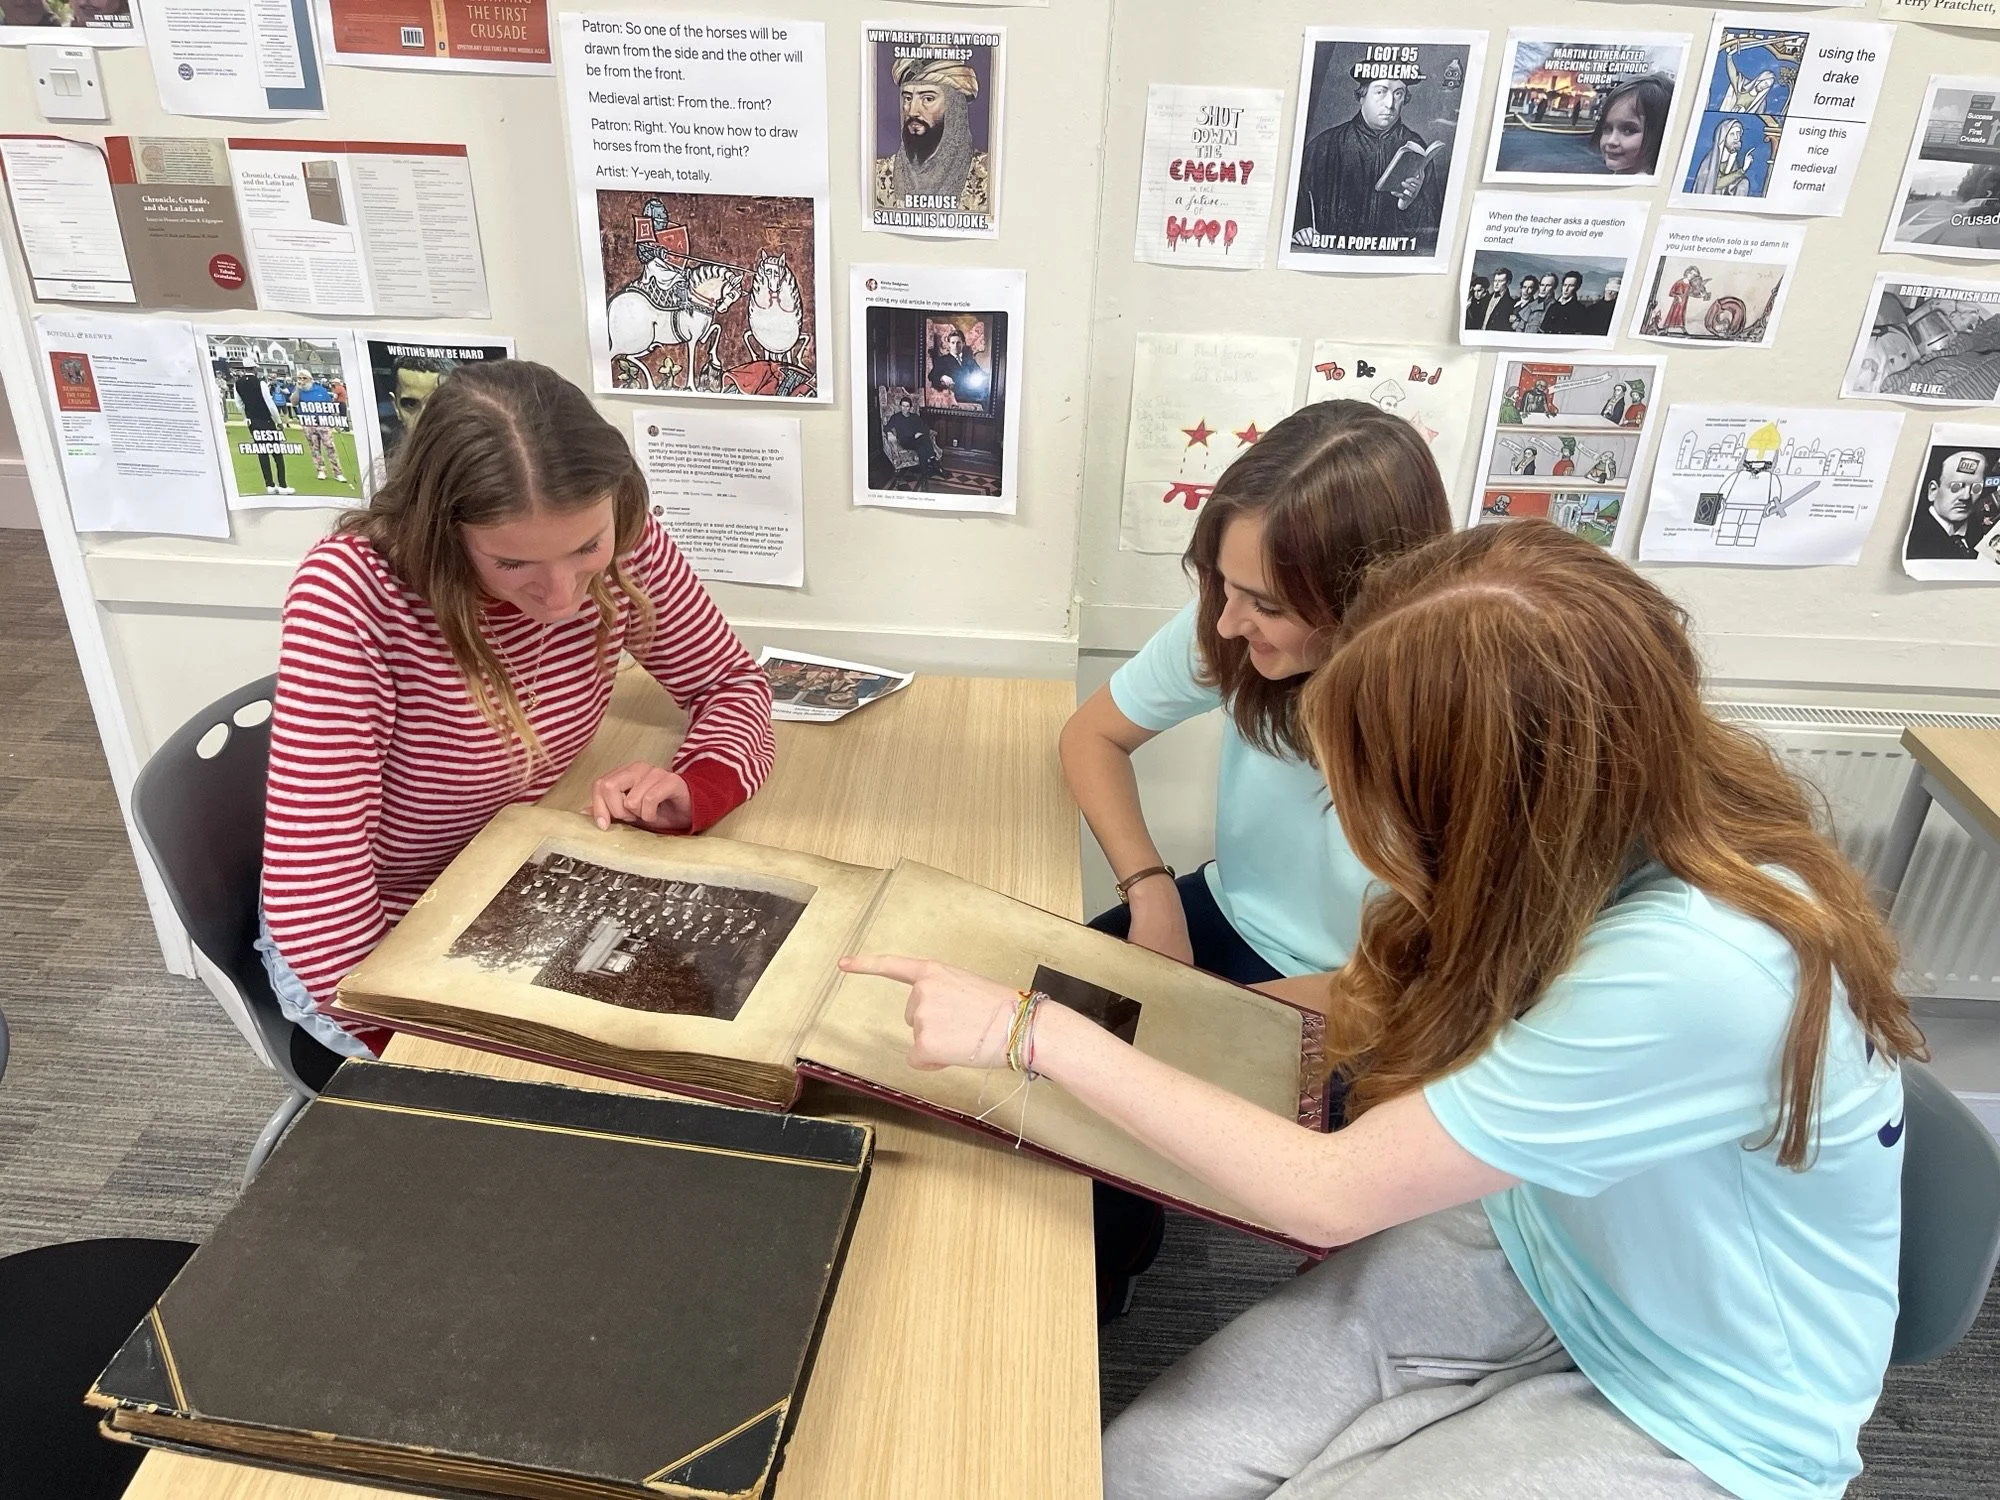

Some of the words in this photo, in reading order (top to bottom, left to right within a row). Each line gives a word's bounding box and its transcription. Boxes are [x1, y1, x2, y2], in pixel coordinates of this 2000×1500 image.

[467, 5, 490, 20] THE
[495, 7, 527, 21] FIRST
[471, 24, 527, 40] CRUSADE
[583, 20, 622, 34] Patron:
[626, 22, 641, 34] So
[645, 25, 666, 36] one
[670, 24, 680, 36] of
[684, 25, 703, 37] the
[706, 26, 747, 39] horses
[750, 28, 768, 39] will
[772, 28, 787, 40] be
[869, 31, 892, 42] WHY
[892, 32, 922, 43] AREN'T
[925, 33, 954, 44] THERE
[954, 34, 973, 45] ANY
[973, 34, 999, 46] GOOD
[585, 42, 620, 55] drawn
[623, 44, 649, 57] from
[653, 45, 671, 58] the
[675, 47, 698, 59] side
[702, 48, 723, 60] and
[727, 49, 746, 61] the
[750, 49, 781, 62] other
[784, 50, 802, 62] will
[895, 47, 932, 58] SALADIN
[935, 49, 972, 60] MEMES?
[1367, 46, 1372, 60] I
[1374, 46, 1400, 61] GOT
[1401, 47, 1418, 61] 95
[1554, 48, 1587, 59] MARTIN
[1588, 50, 1619, 60] LUTHER
[1620, 51, 1644, 60] AFTER
[1819, 47, 1854, 63] using
[1857, 49, 1875, 62] the
[586, 64, 600, 76] be
[604, 64, 630, 77] from
[634, 66, 652, 78] the
[655, 67, 685, 80] front.
[1354, 63, 1426, 79] PROBLEMS...
[1544, 60, 1590, 71] WRECKING
[1593, 62, 1607, 72] THE
[1609, 63, 1648, 73] CATHOLIC
[1578, 74, 1612, 84] CHURCH
[1823, 70, 1859, 84] drake
[589, 91, 640, 104] Medieval
[643, 95, 674, 106] artist:
[678, 96, 707, 108] From
[711, 97, 735, 109] the..
[738, 98, 772, 110] front?
[1814, 93, 1855, 107] format
[1196, 106, 1244, 128] SHUT
[591, 118, 631, 131] Patron:
[634, 120, 666, 134] Right.
[669, 122, 690, 134] You
[694, 123, 724, 135] know
[728, 124, 752, 136] how
[755, 126, 766, 137] to
[770, 126, 798, 138] draw
[1799, 126, 1826, 139] using
[1829, 128, 1847, 138] this
[1192, 128, 1237, 145] DOWN
[593, 139, 632, 152] horses
[635, 141, 661, 153] from
[664, 142, 682, 154] the
[685, 143, 714, 157] front,
[717, 145, 749, 158] right?
[1196, 145, 1222, 158] THE
[1807, 145, 1829, 155] nice
[596, 165, 628, 177] Artist:
[631, 166, 674, 181] Y-yeah,
[677, 169, 712, 183] totally.
[1170, 159, 1254, 185] ENEMY
[1790, 163, 1837, 174] medieval
[1793, 180, 1825, 191] format
[179, 196, 210, 204] Crusade,
[906, 195, 956, 208] BECAUSE
[874, 211, 923, 227] SALADIN
[926, 213, 937, 227] IS
[940, 214, 955, 227] NO
[958, 214, 988, 229] JOKE.
[1488, 211, 1512, 221] When
[1515, 213, 1528, 222] the
[1530, 215, 1561, 224] teacher
[1564, 217, 1582, 225] asks
[1591, 218, 1625, 227] question
[1167, 216, 1238, 255] BLOOD
[1503, 225, 1529, 234] you're
[1531, 227, 1554, 237] trying
[1556, 228, 1564, 236] to
[1566, 229, 1587, 237] avoid
[1312, 234, 1336, 248] BUT
[1337, 236, 1345, 249] A
[1348, 236, 1378, 250] POPE
[1378, 237, 1409, 251] AIN'T
[1410, 237, 1416, 251] 1
[1484, 236, 1513, 244] contact
[1669, 233, 1689, 241] When
[1692, 234, 1703, 242] the
[1706, 236, 1725, 244] violin
[1743, 238, 1749, 246] is
[1760, 239, 1780, 247] damn
[1666, 243, 1679, 251] you
[1681, 244, 1695, 252] just
[1697, 244, 1726, 254] become
[1734, 247, 1752, 257] bagel
[1900, 286, 1933, 297] BRIBED
[1934, 288, 1980, 301] FRANKISH
[387, 345, 426, 357] WRITING
[427, 348, 445, 358] MAY
[446, 349, 458, 359] BE
[459, 349, 484, 359] HARD
[1315, 361, 1345, 381] To
[1356, 360, 1376, 378] Be
[1408, 364, 1442, 385] Red
[1910, 382, 1922, 393] BE
[300, 402, 340, 413] ROBERT
[298, 414, 317, 426] THE
[320, 415, 348, 428] MONK
[253, 430, 286, 441] GESTA
[239, 443, 304, 454] FRANCORUM
[1960, 461, 1976, 470] DIE
